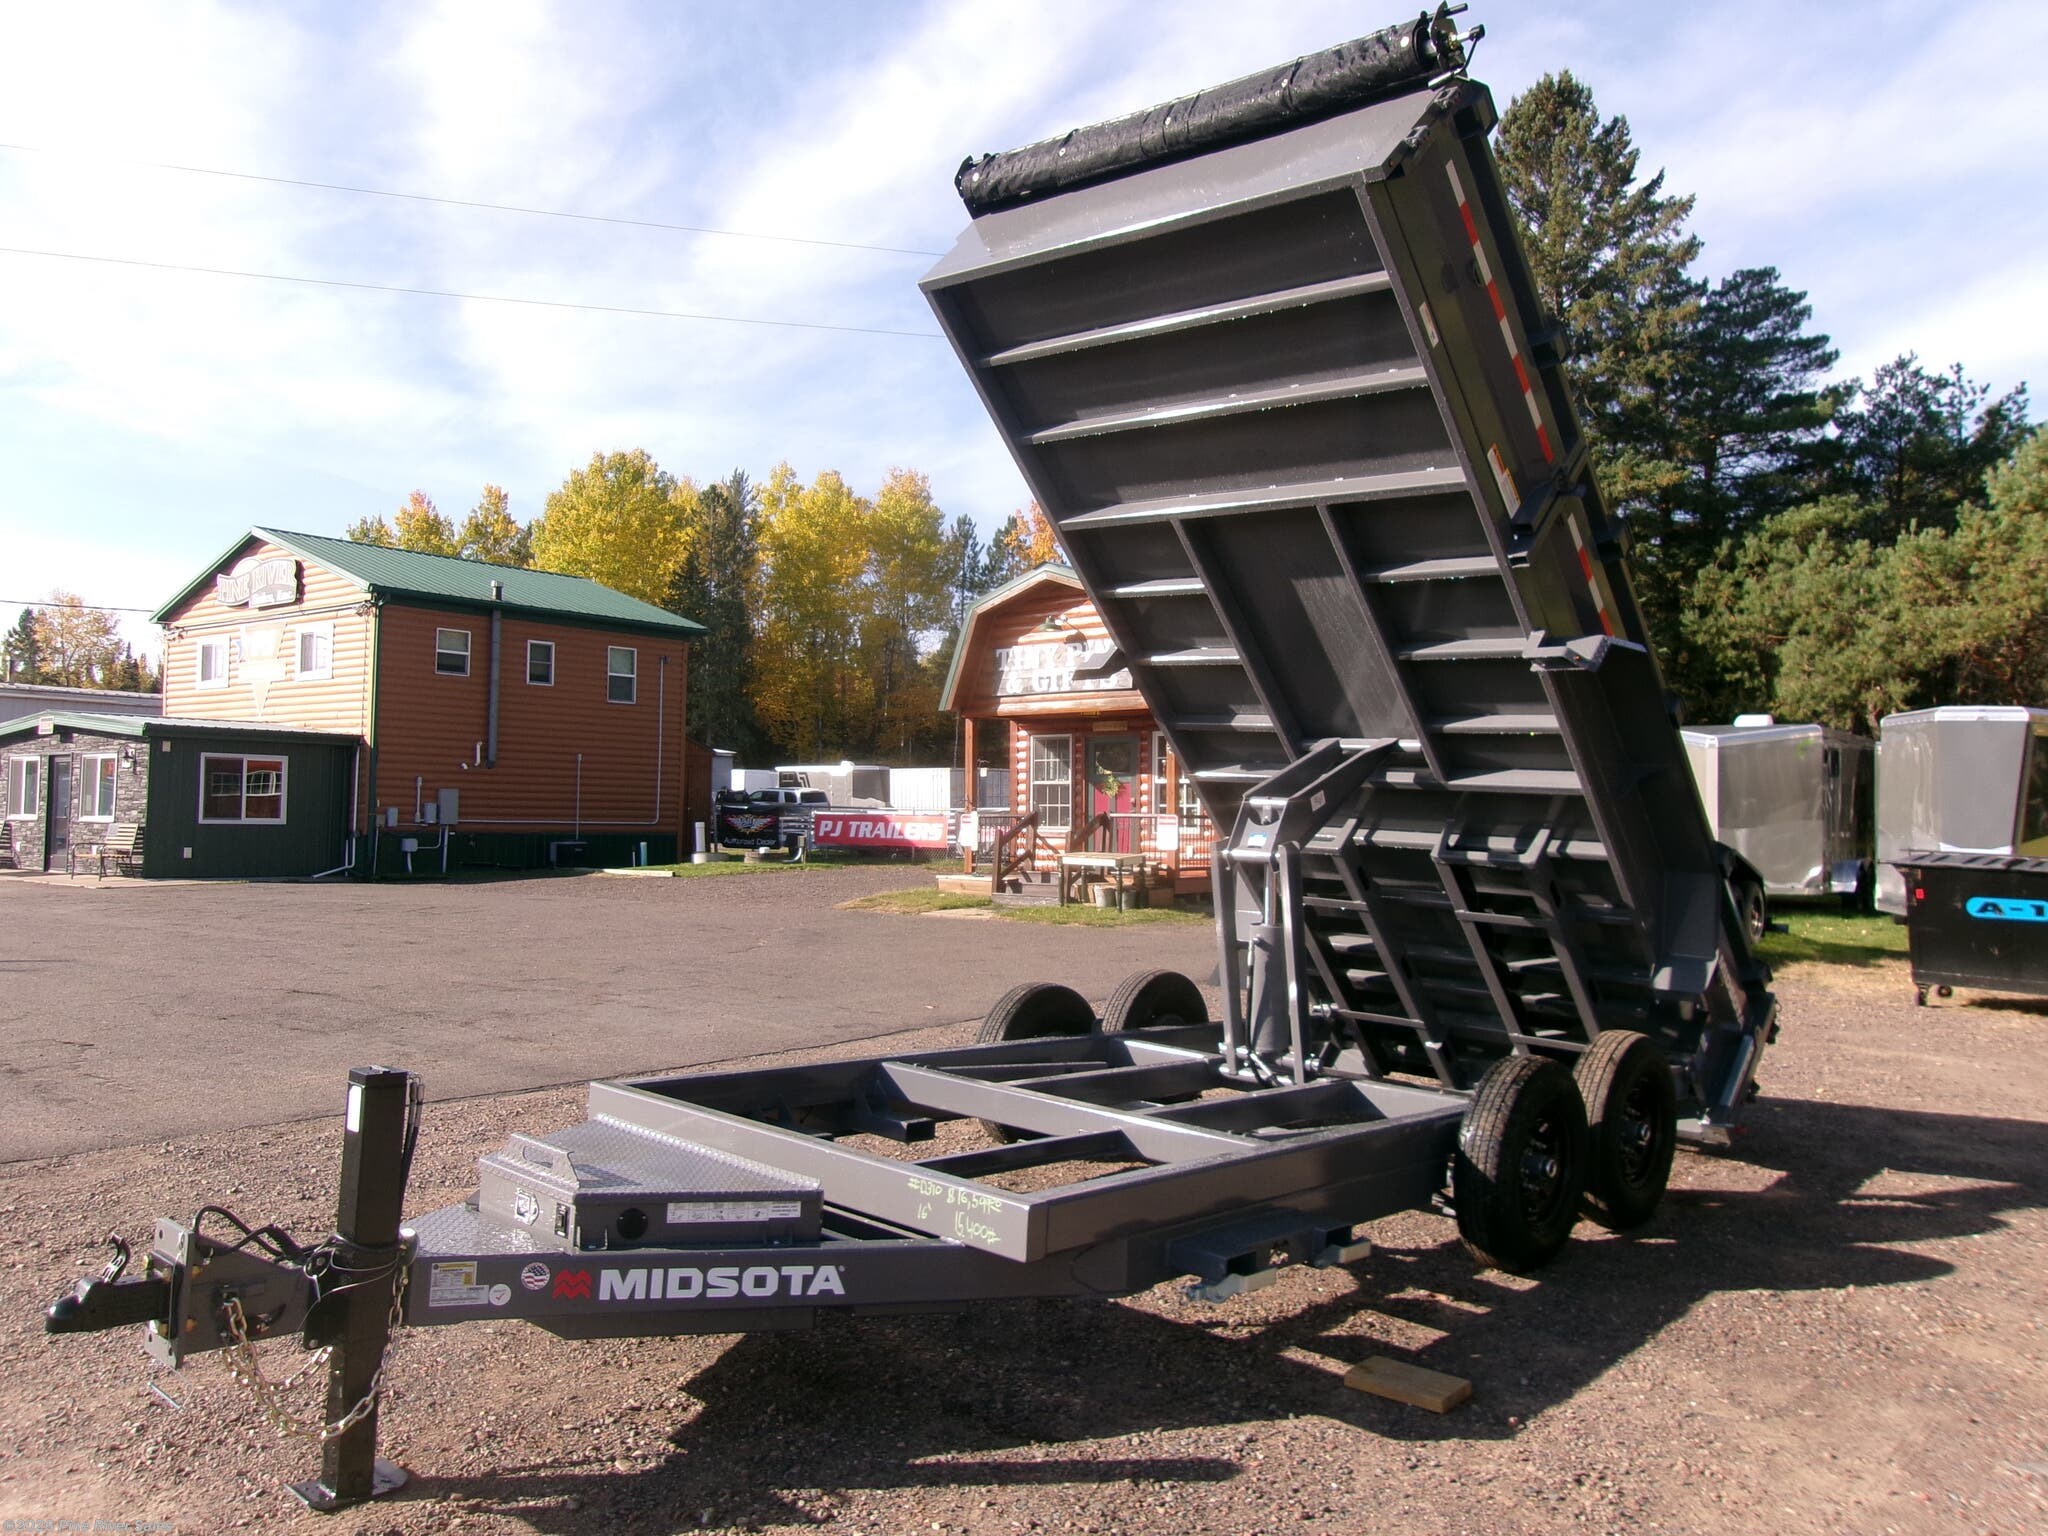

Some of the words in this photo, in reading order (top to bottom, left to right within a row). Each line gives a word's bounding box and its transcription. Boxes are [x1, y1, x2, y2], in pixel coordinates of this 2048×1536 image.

[819, 820, 843, 837] PJ
[849, 821, 944, 841] TRAILERS
[1976, 902, 2046, 917] A-1
[599, 1265, 846, 1300] MIDSOTA
